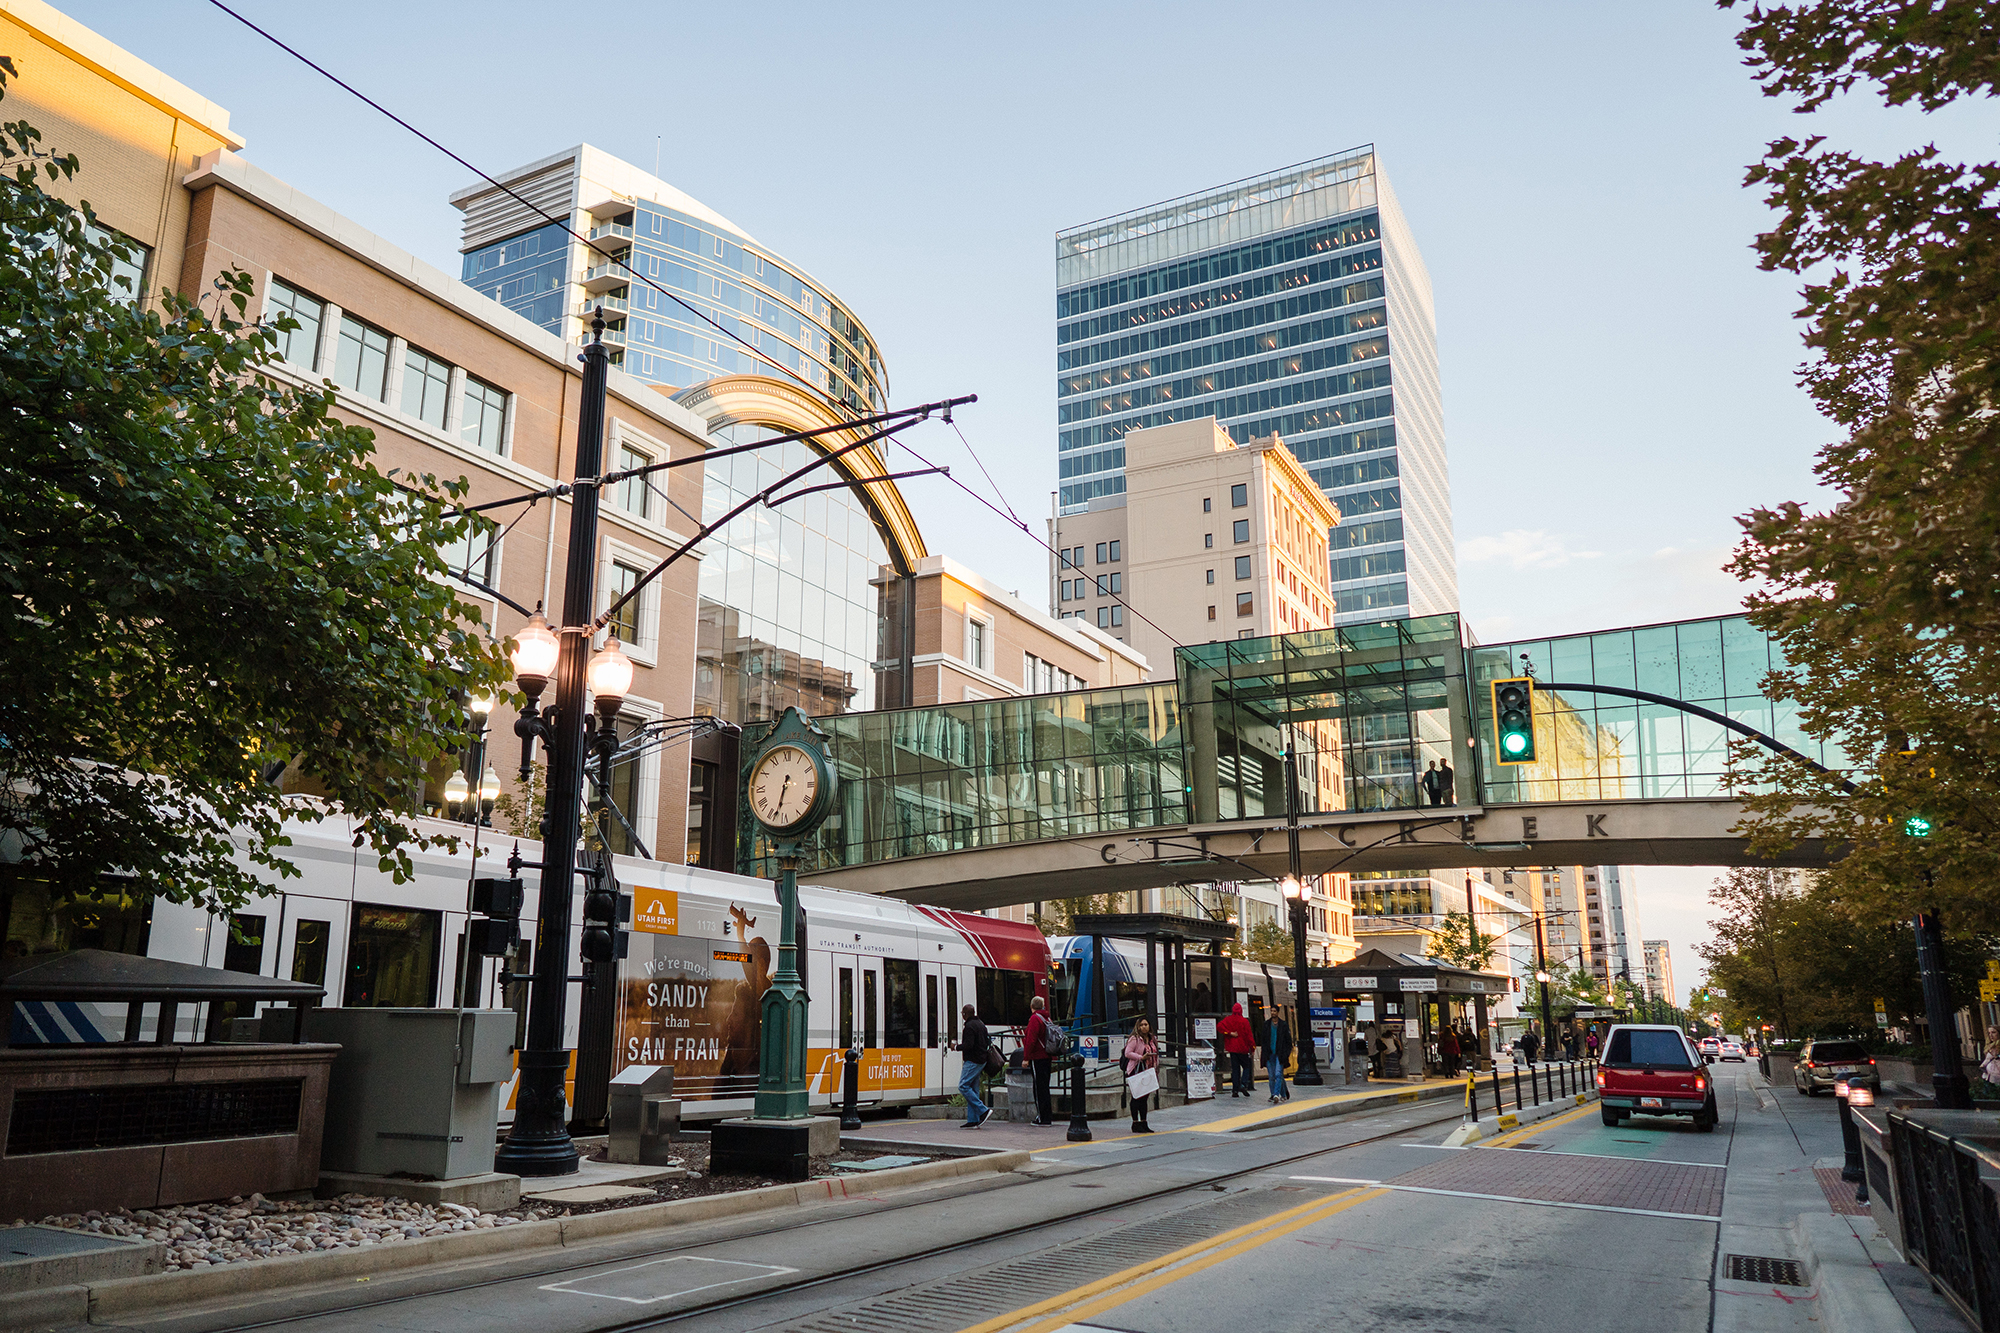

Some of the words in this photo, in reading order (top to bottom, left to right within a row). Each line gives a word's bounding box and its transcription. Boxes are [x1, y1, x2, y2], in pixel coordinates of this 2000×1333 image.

[780, 731, 802, 741] LAKE
[803, 733, 819, 747] CITY
[1101, 831, 1263, 864] CITY
[1338, 813, 1609, 846] CREEK
[637, 914, 656, 923] UTAH
[657, 916, 675, 926] FIRST
[697, 920, 717, 932] 1173
[837, 942, 861, 950] TRANSIT
[864, 945, 895, 953] AUTHORITY
[644, 955, 680, 976] We're
[683, 960, 712, 980] more
[647, 982, 708, 1009] SANDY
[665, 1013, 690, 1028] than
[627, 1036, 666, 1061] SAN
[674, 1037, 719, 1061] FRAN
[891, 1054, 901, 1062] PUT
[868, 1065, 889, 1080] UTAH
[891, 1064, 914, 1079] FIRST
